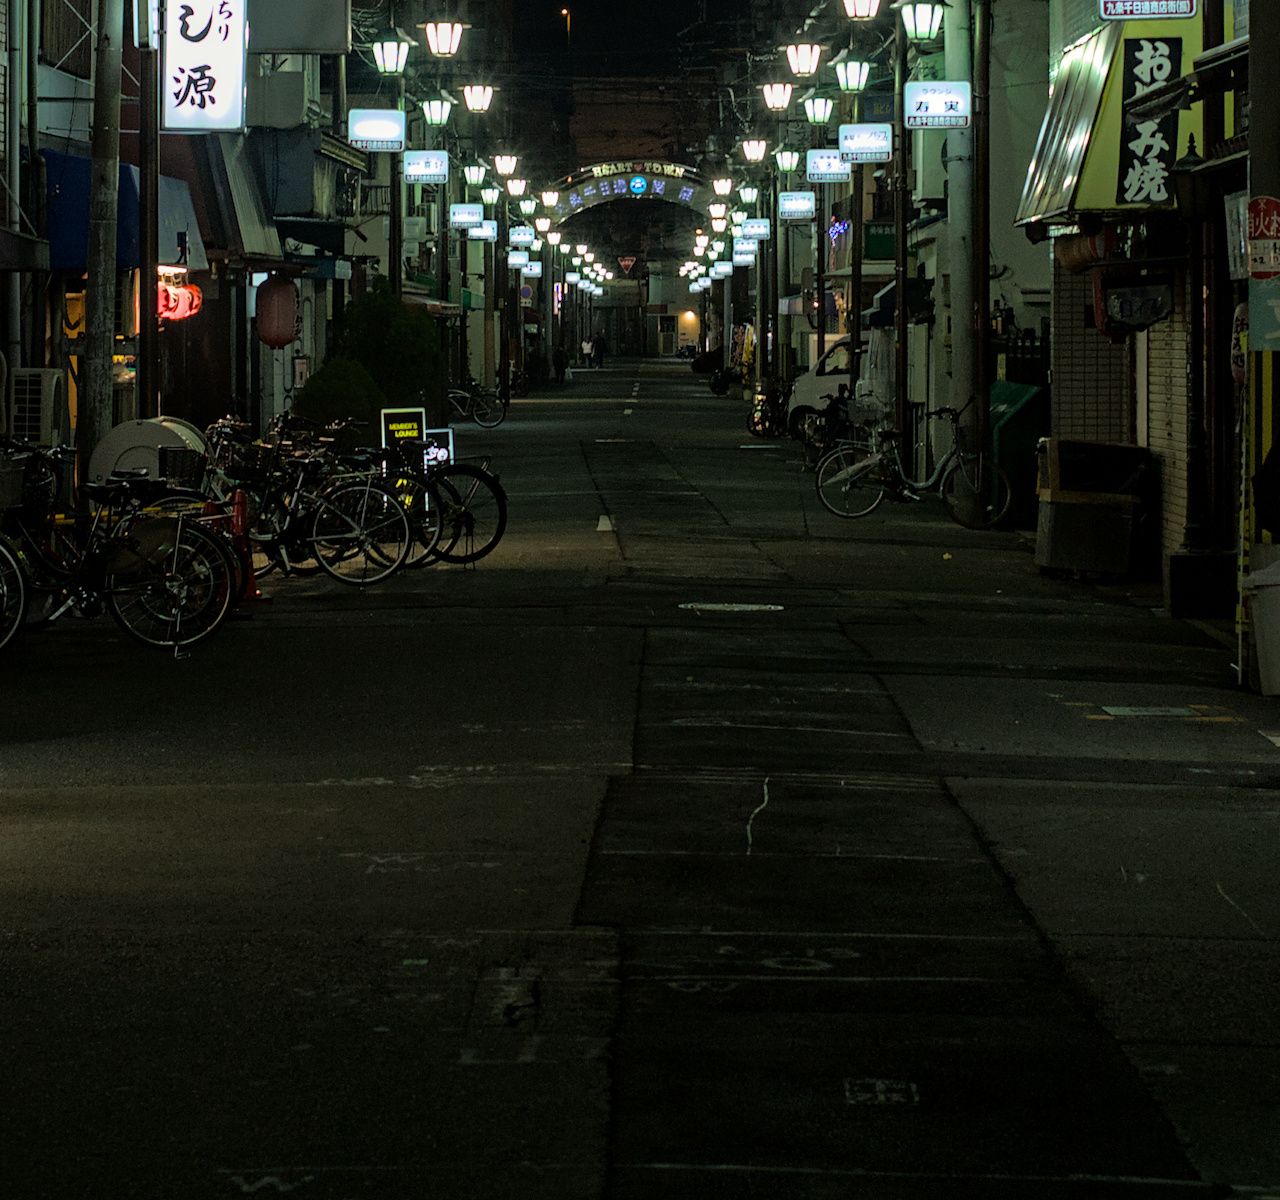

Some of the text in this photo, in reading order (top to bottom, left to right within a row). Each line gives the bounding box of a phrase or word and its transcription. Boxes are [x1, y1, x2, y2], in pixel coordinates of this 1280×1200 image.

[1123, 40, 1173, 202] おみ焼
[592, 162, 685, 178] HEART TOWN
[388, 422, 419, 431] MEMBER'S
[395, 430, 419, 438] LOUNGE
